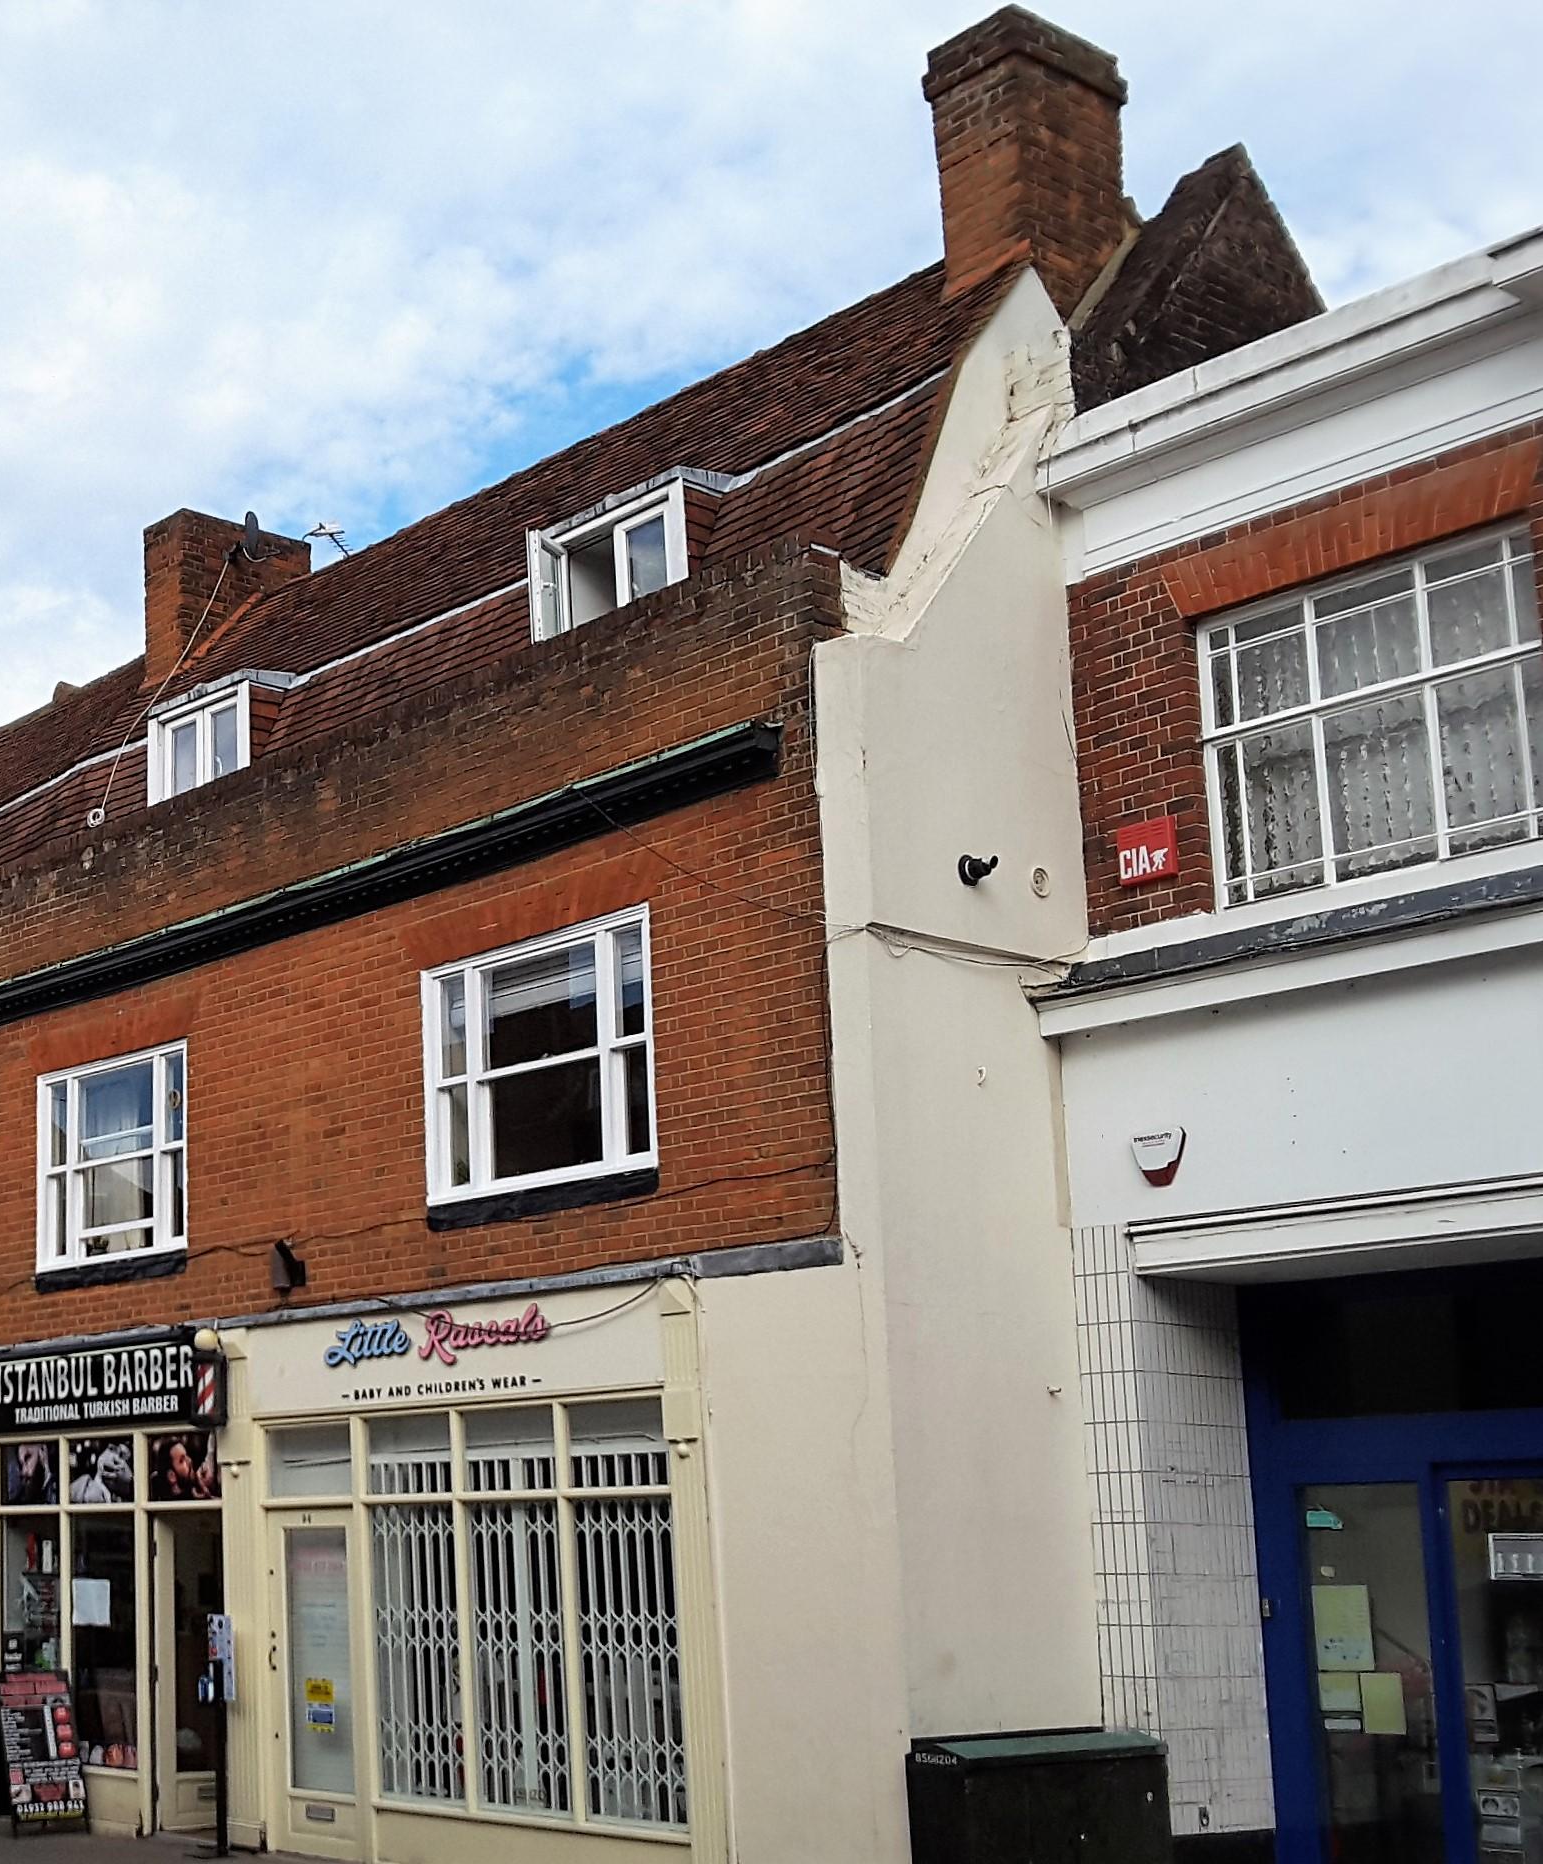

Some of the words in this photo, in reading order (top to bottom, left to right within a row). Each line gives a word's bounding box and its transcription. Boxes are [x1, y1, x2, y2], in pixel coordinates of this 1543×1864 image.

[1118, 844, 1152, 881] CIA
[323, 1318, 411, 1369] Little
[418, 1302, 550, 1366] Rascals
[103, 1345, 194, 1395] BARBER
[354, 1386, 382, 1401] BABY
[388, 1384, 412, 1398] AND
[417, 1377, 486, 1394] CHILDREN'S
[491, 1375, 528, 1390] WEAR
[15, 1402, 81, 1425] TRADITIONAL
[83, 1398, 131, 1419] TURKISH
[132, 1394, 179, 1416] BARBER
